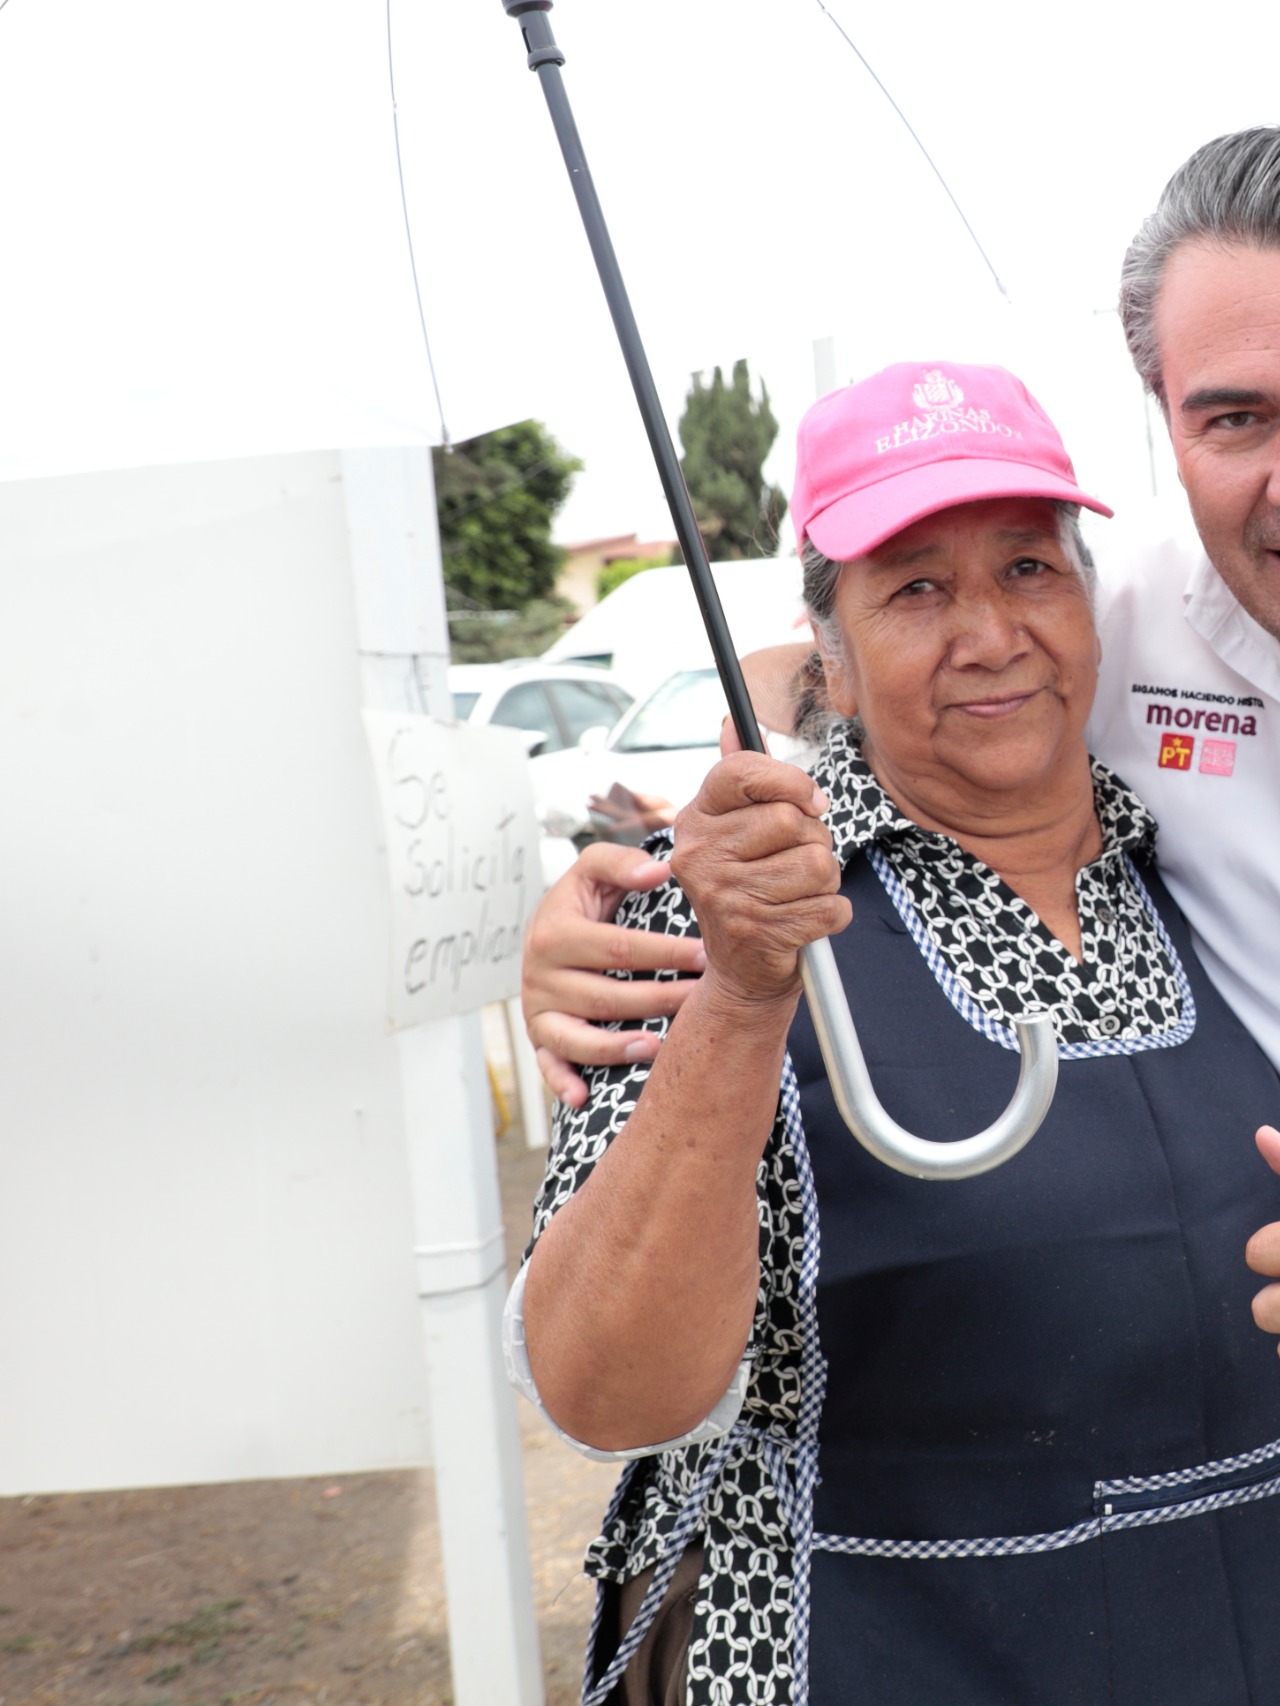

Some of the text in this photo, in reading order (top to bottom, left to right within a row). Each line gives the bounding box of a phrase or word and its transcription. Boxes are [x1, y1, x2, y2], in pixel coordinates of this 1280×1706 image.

[874, 418, 1013, 454] ELIZONDO
[893, 406, 990, 436] HARINAS
[1131, 684, 1178, 698] SIGAMOS
[1180, 690, 1235, 705] HACIENDO
[1146, 703, 1257, 736] morena
[1161, 746, 1190, 767] PT
